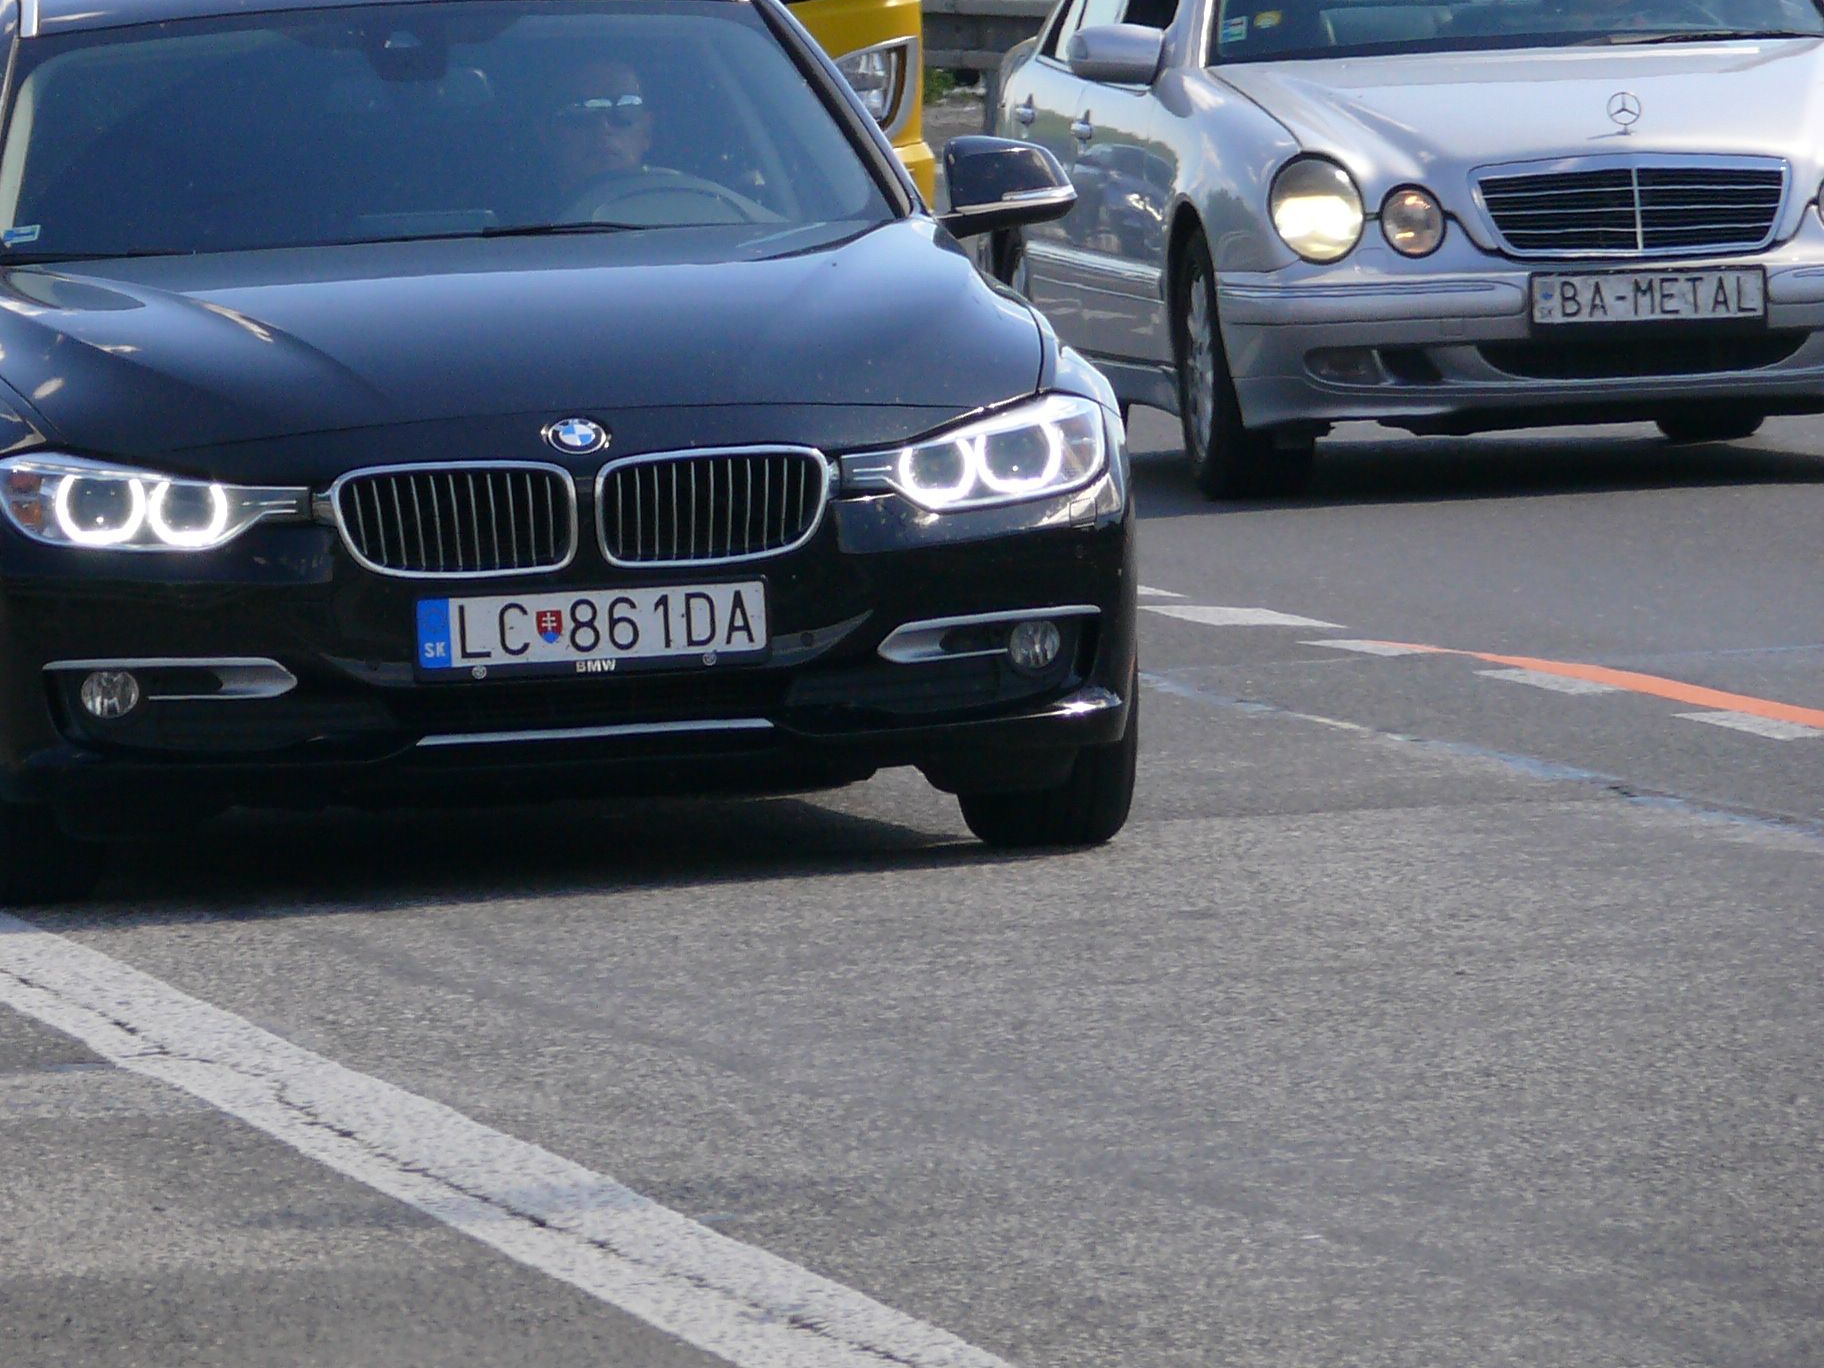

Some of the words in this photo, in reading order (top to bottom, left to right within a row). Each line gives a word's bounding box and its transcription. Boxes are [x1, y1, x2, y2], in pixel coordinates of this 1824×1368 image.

[1559, 275, 1758, 318] BA-METAL
[424, 641, 446, 658] SK
[576, 659, 617, 673] BMW
